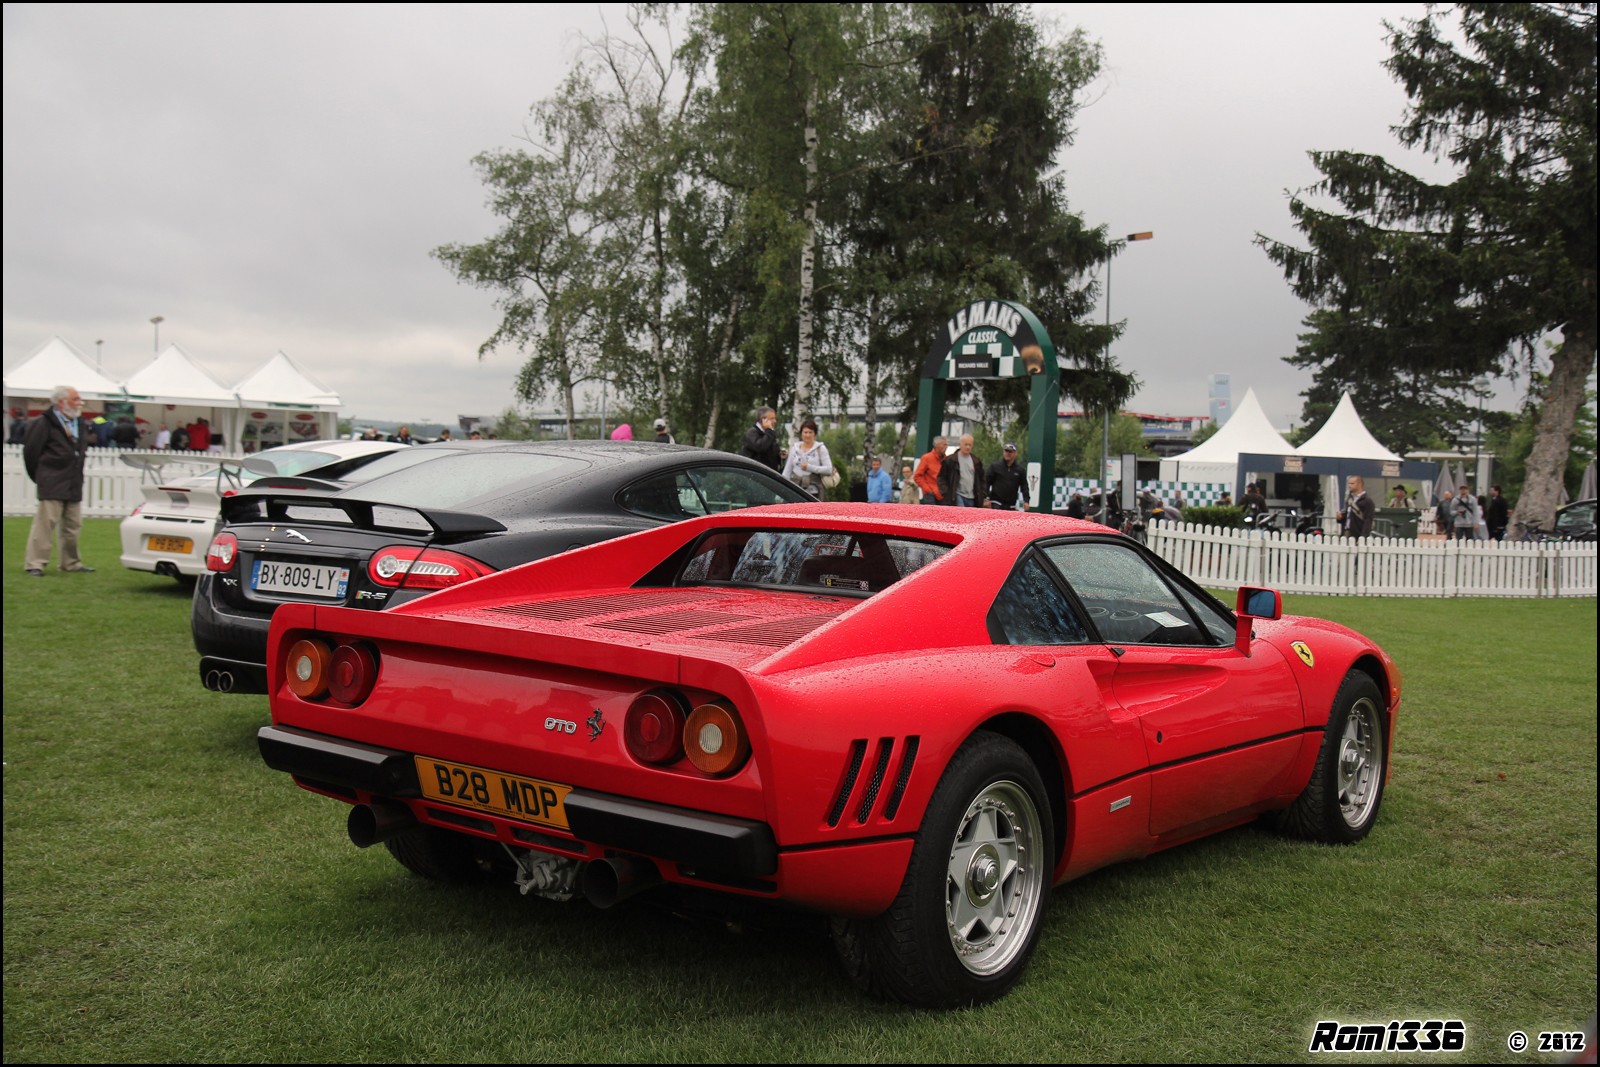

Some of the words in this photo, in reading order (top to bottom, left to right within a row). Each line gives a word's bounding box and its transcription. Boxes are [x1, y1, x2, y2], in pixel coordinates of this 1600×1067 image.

[948, 309, 967, 344] LE
[968, 301, 1022, 337] MANS
[968, 330, 999, 344] CLASSIC
[337, 585, 346, 595] 92
[544, 717, 577, 734] GTO
[433, 763, 490, 804] B28
[500, 777, 558, 819] MDP
